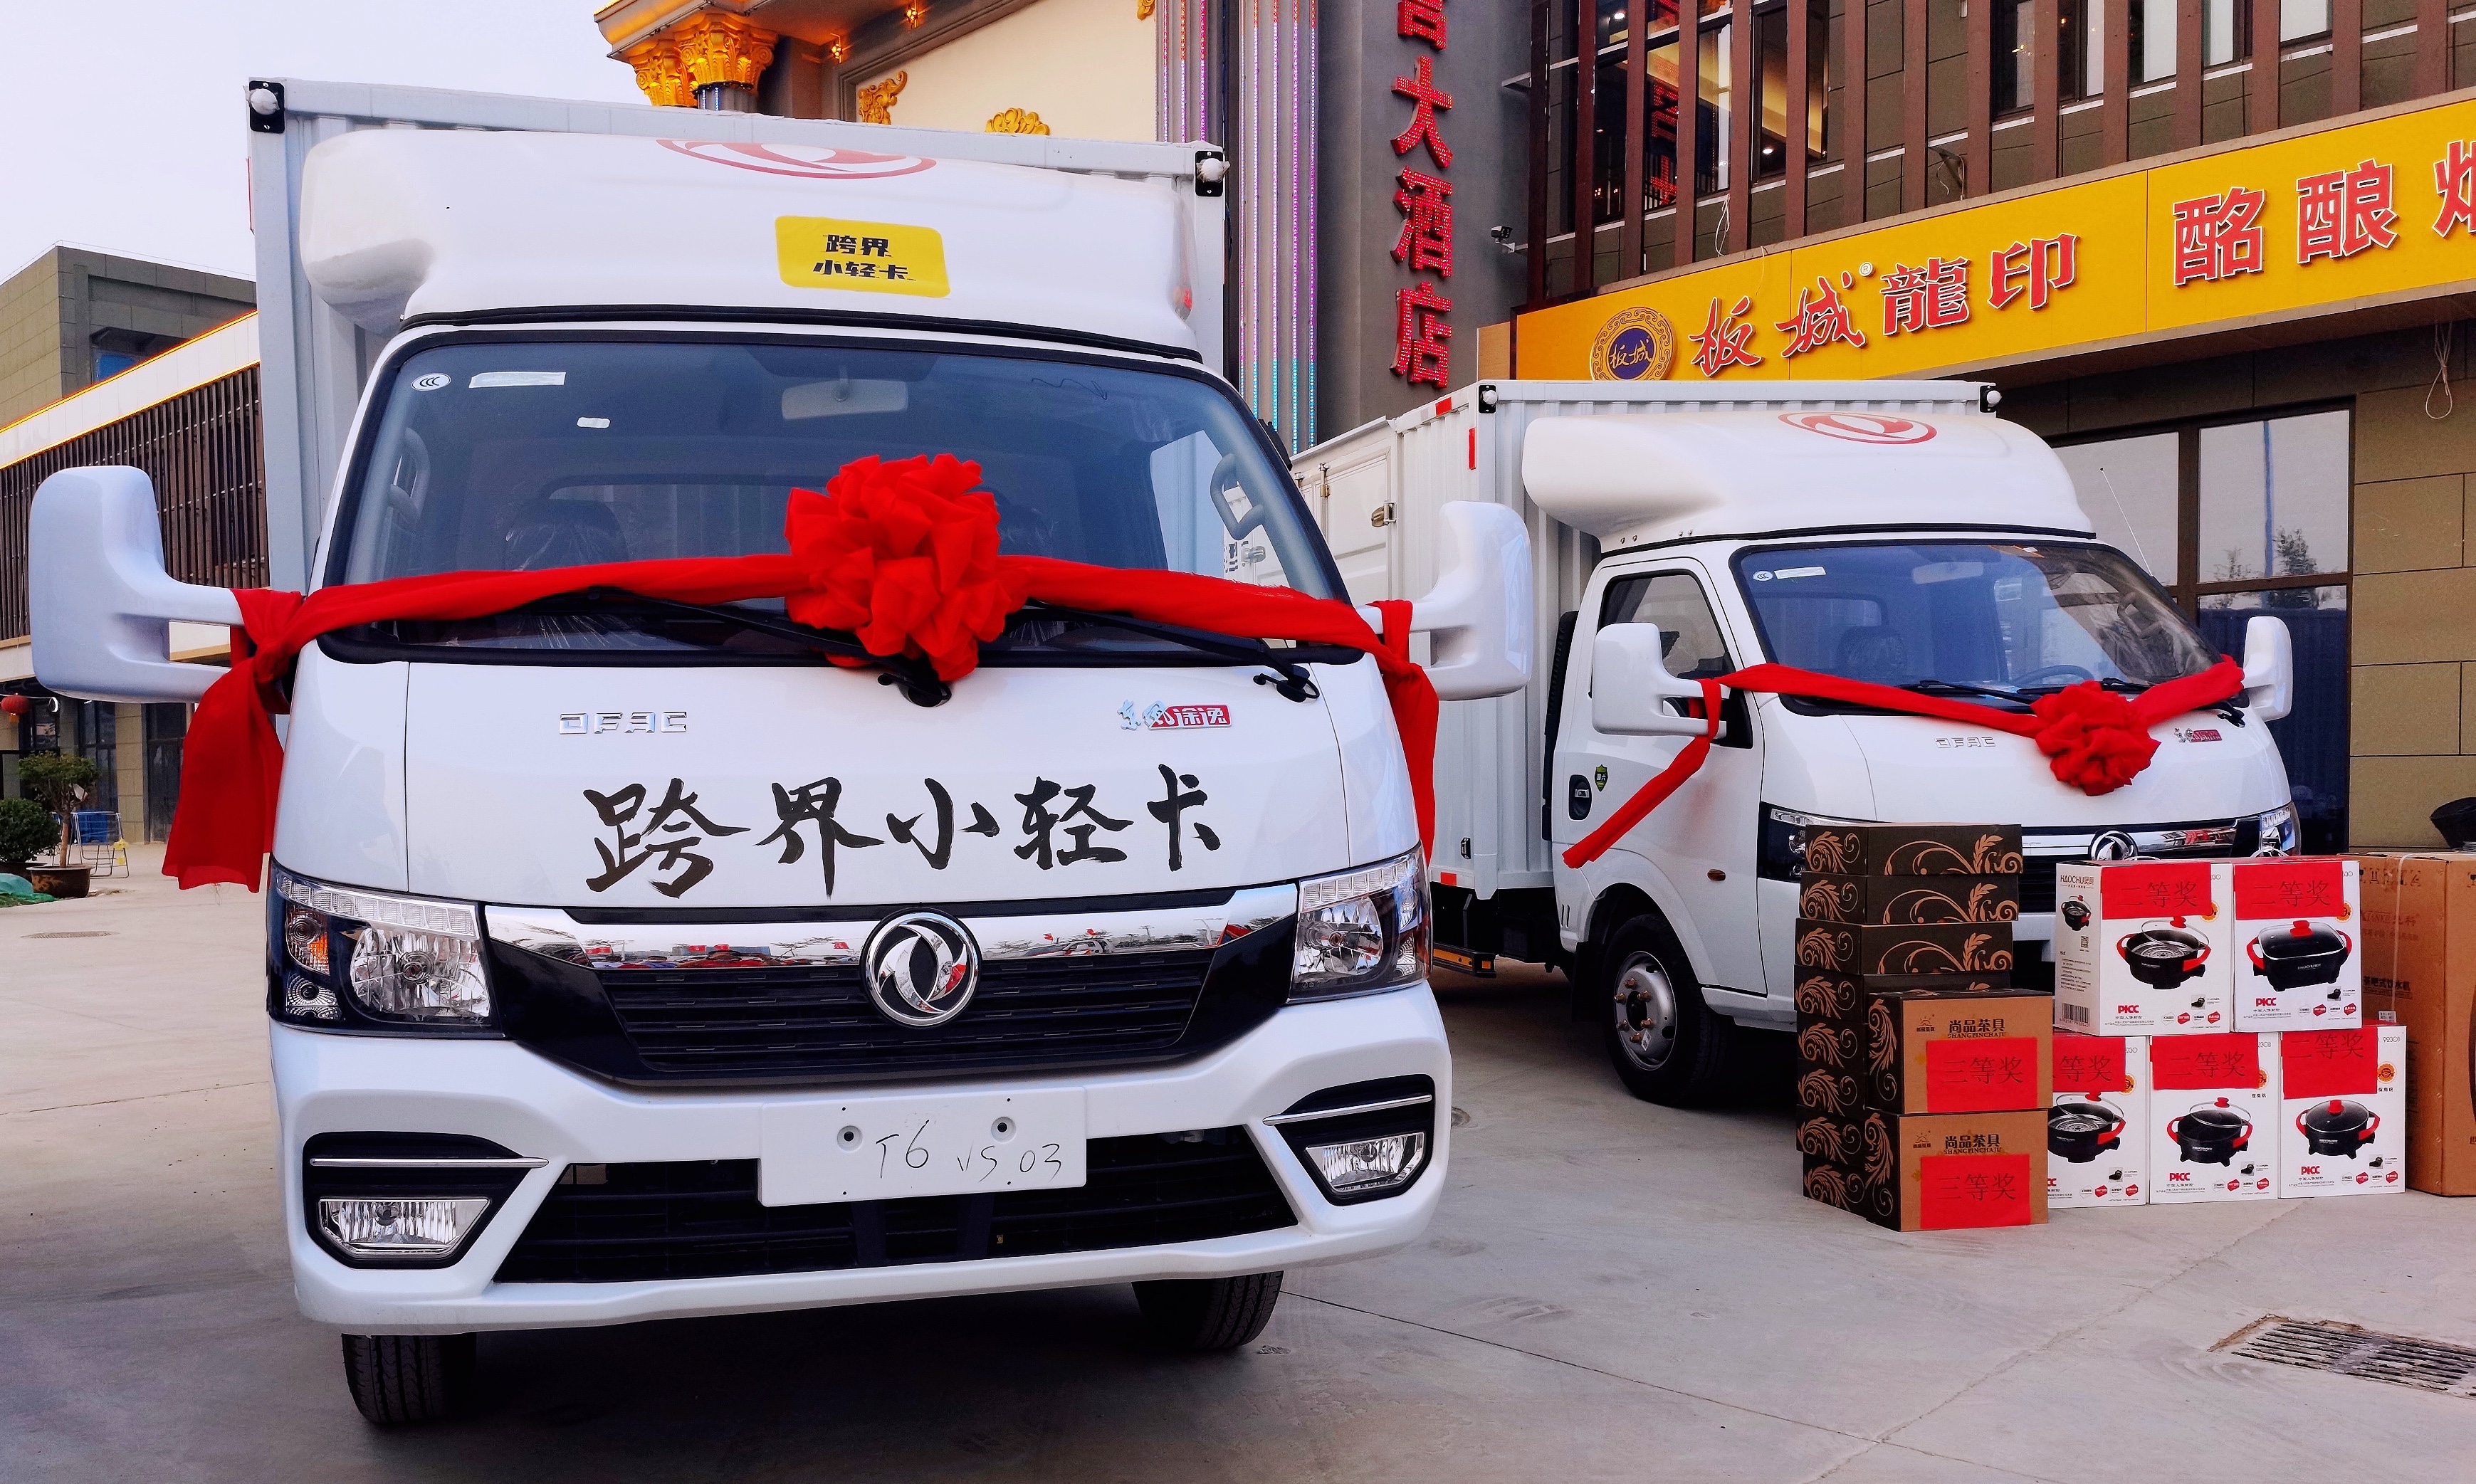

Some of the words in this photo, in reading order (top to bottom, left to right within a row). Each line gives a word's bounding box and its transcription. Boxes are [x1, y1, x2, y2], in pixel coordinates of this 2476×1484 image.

[824, 233, 890, 258] 跨界
[813, 259, 912, 280] 小轻卡
[1609, 336, 1652, 369] 板城
[582, 764, 1220, 899] 跨界小轻卡
[2118, 880, 2198, 907] 二等奖
[2251, 880, 2331, 907] 二等奖
[2118, 1005, 2139, 1014] PICC
[2255, 997, 2277, 1007] PICC
[1948, 1019, 2005, 1033] 尚品茶具
[2289, 1033, 2365, 1060] 二等奖
[1942, 1056, 2024, 1084] 三等奖
[2052, 1054, 2112, 1083] 等奖
[2168, 1051, 2245, 1078] 二等奖
[876, 1120, 930, 1179] T6
[1945, 1134, 2000, 1149] 尚品茶具
[2169, 1172, 2191, 1182] PICC
[2301, 1166, 2320, 1175] PICC
[1936, 1172, 2015, 1201] 三等奖
